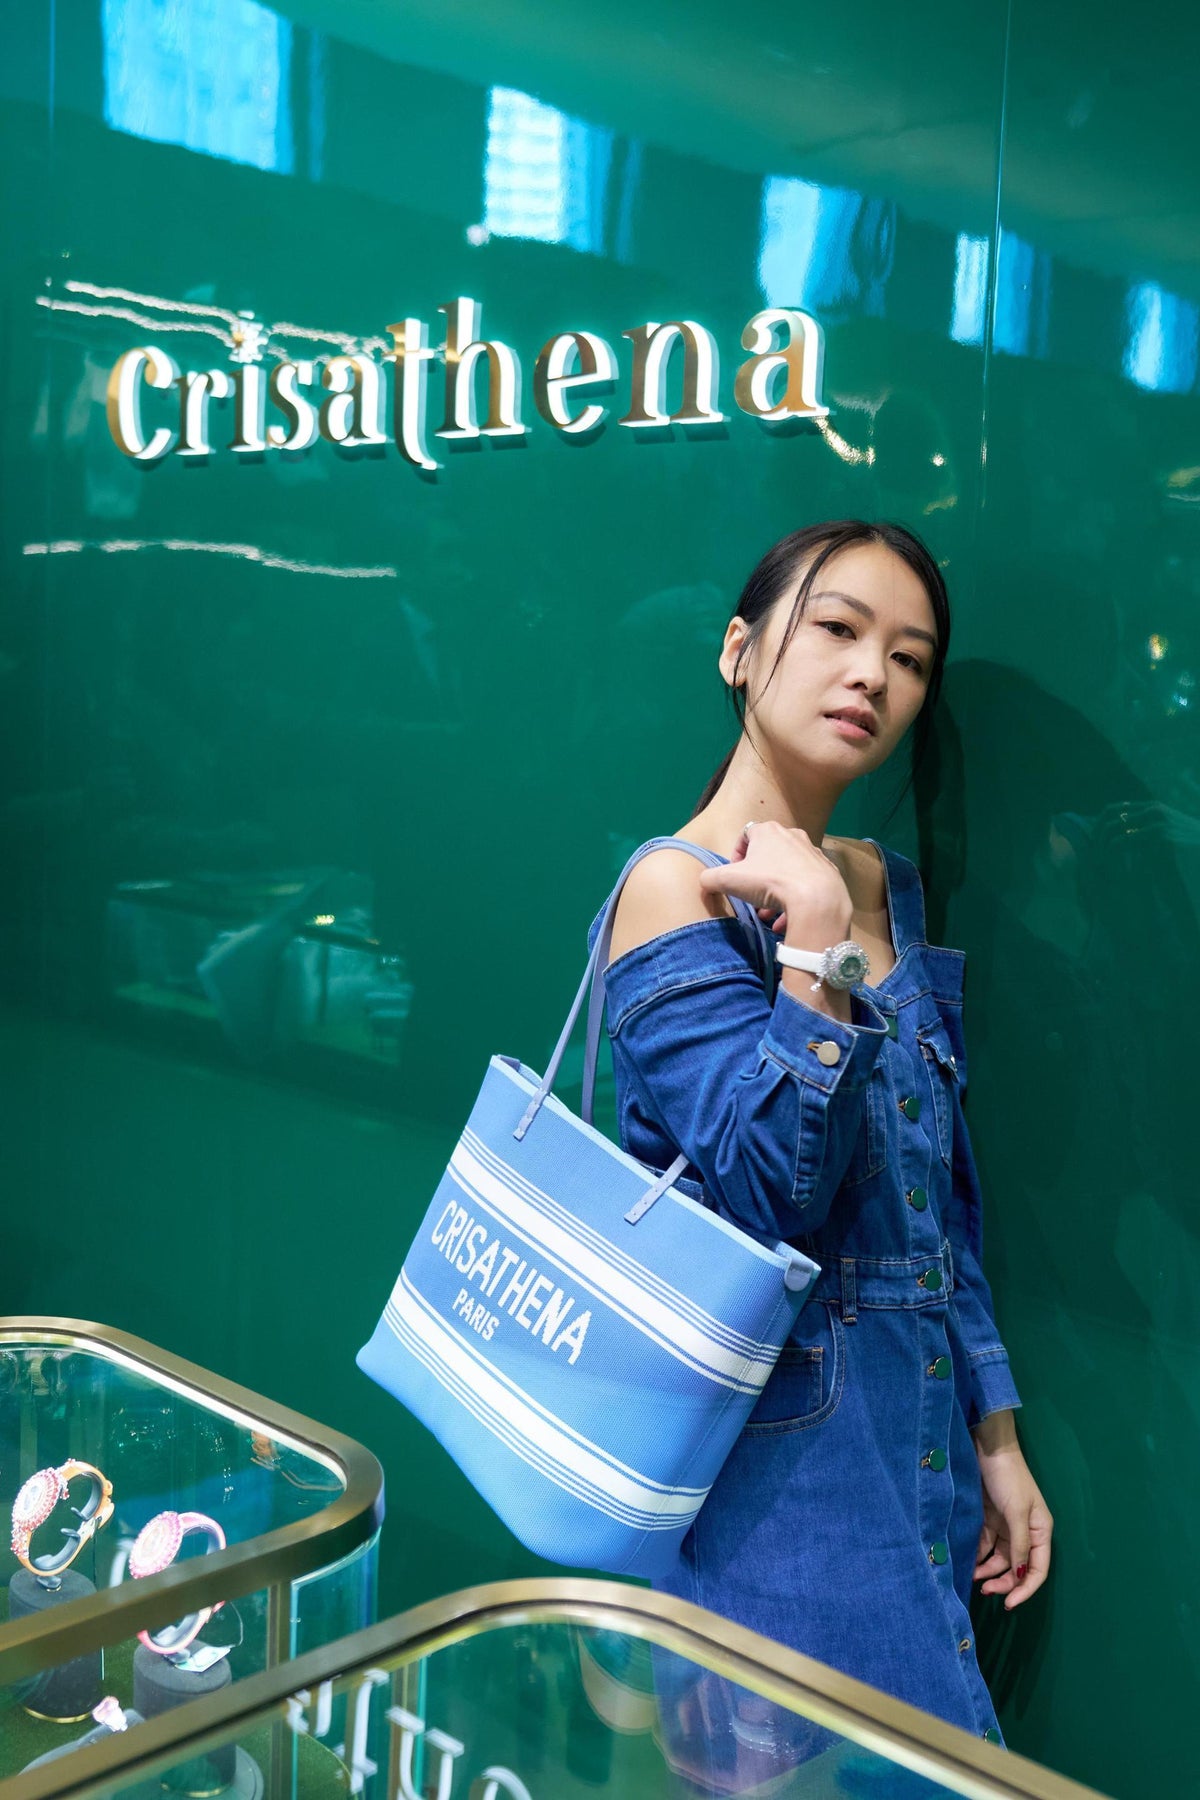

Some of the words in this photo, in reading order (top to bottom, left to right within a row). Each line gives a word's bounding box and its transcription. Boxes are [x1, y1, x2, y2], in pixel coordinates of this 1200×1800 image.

[107, 297, 829, 470] Crisathena
[431, 1199, 592, 1365] CRISATHENA
[452, 1288, 500, 1341] PARIS
